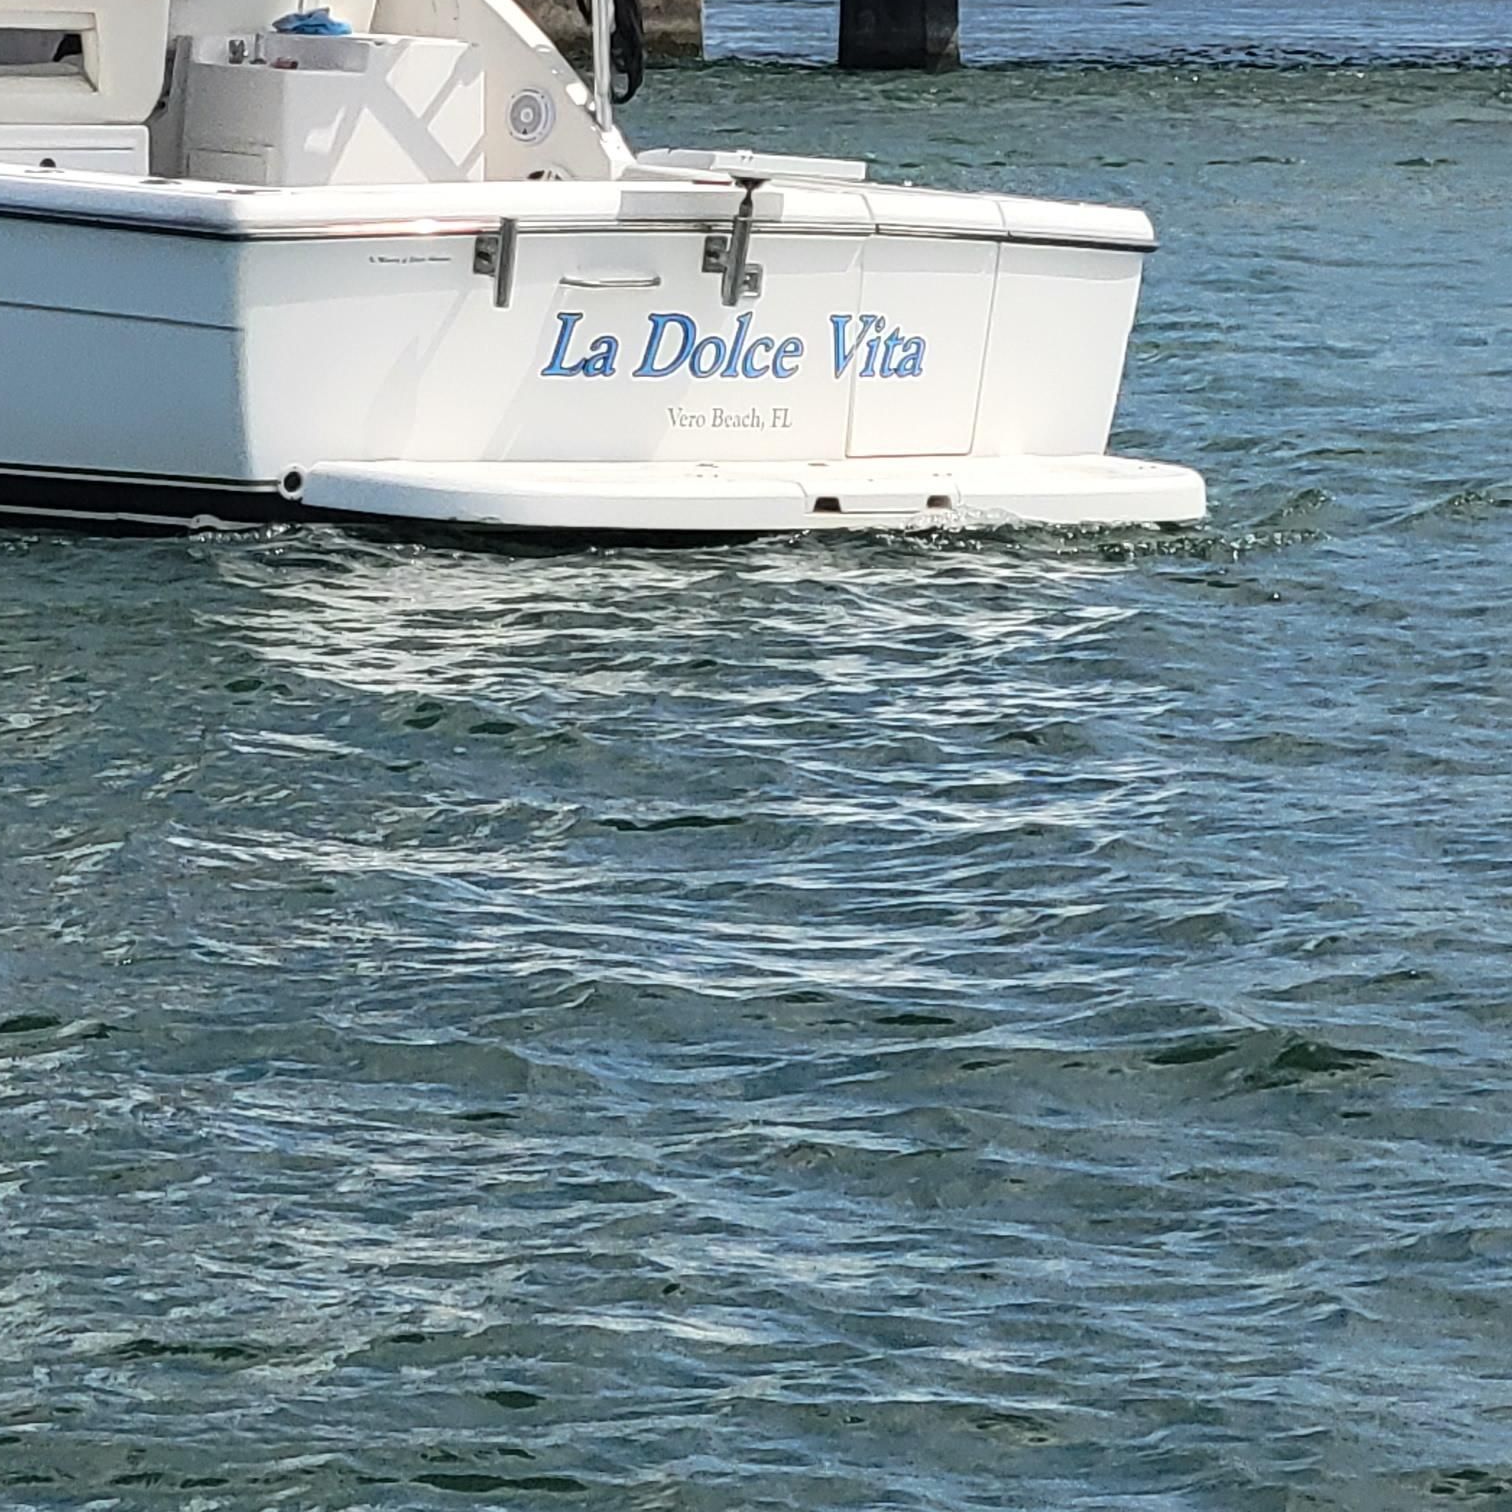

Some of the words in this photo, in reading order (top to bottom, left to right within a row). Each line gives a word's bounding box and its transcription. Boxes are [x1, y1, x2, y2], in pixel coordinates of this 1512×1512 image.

[540, 311, 619, 378] La
[632, 310, 805, 379] Dolce
[829, 314, 926, 379] Vita
[667, 407, 706, 428] Vero
[711, 407, 765, 432] Beach,
[771, 407, 792, 428] FL
